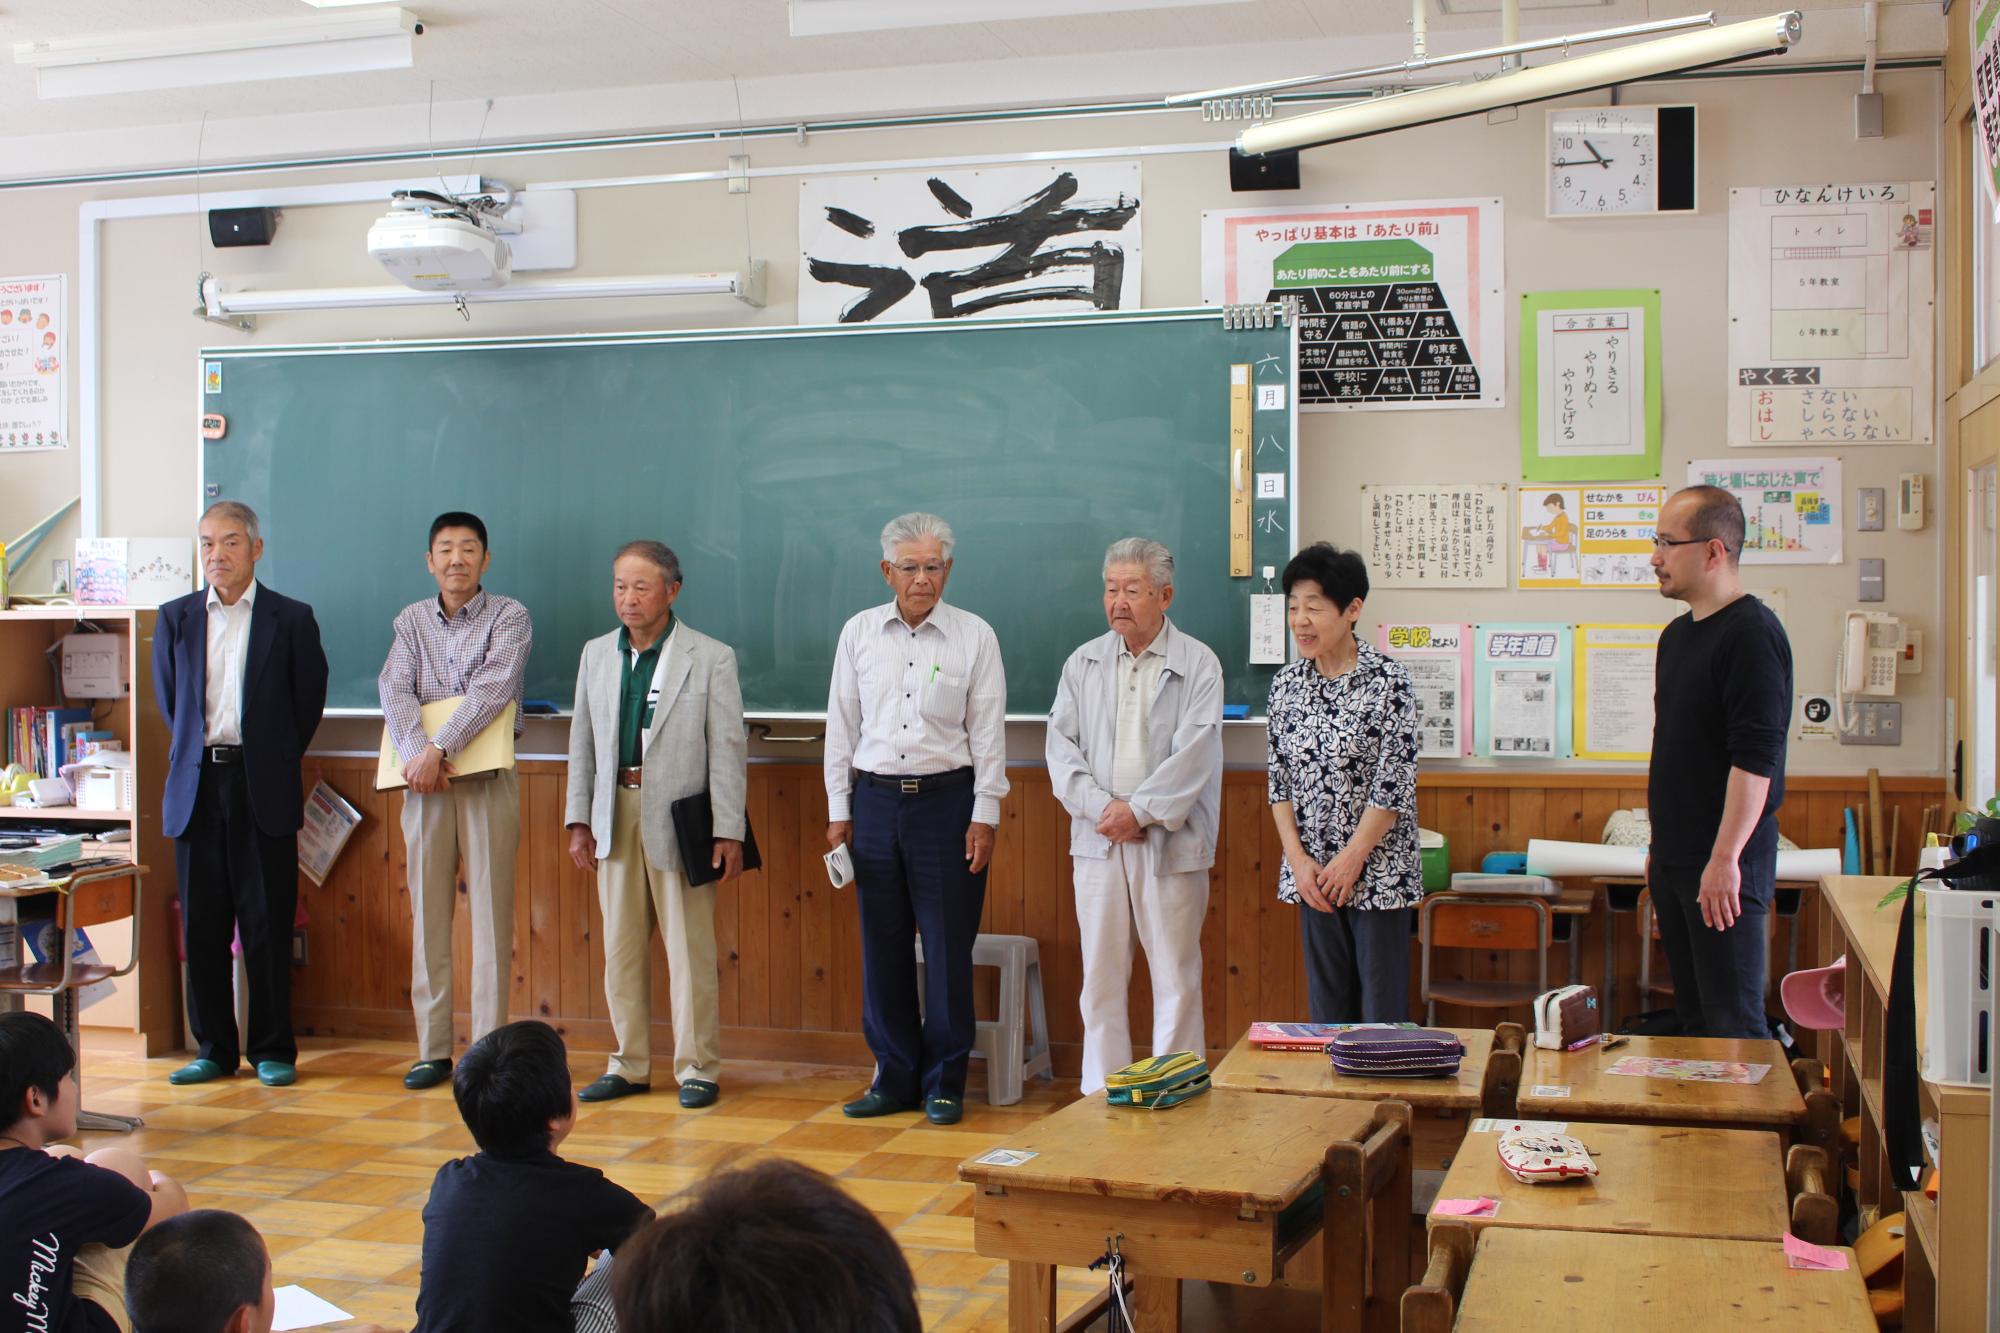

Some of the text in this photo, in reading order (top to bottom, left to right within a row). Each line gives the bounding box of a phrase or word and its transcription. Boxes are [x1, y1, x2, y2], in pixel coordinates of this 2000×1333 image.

[1597, 117, 1607, 128] 12
[1563, 137, 1573, 149] 10
[1633, 136, 1640, 147] 2
[1639, 154, 1647, 166] 3
[1564, 176, 1571, 188] 8
[1633, 174, 1640, 185] 4
[1580, 190, 1587, 202] 7
[1618, 189, 1626, 200] 5
[1775, 185, 1895, 204] ひなんけいろ
[1598, 195, 1606, 206] 6
[1256, 221, 1441, 242] やっぱり基本は「あたり前」
[1793, 226, 1846, 236] トイレ
[1276, 263, 1431, 281] あたり前のことをあたり前にする
[1799, 277, 1840, 287] 5年教室
[1329, 290, 1376, 300] 60分以上の
[1341, 320, 1368, 330] 宿題の
[1424, 316, 1445, 327] 言葉
[1566, 316, 1616, 329] 合言葉
[1304, 330, 1323, 340] 守る
[1386, 327, 1405, 337] 行動
[1420, 328, 1450, 338] づかい
[1799, 327, 1840, 337] 6年教室
[1428, 343, 1458, 354] 約束を
[1433, 356, 1453, 366] 守る
[1605, 336, 1619, 394] やりきる
[1333, 371, 1368, 383] 学校に
[1584, 350, 1598, 409] やりぬく
[1740, 367, 1817, 385] やくそく
[1341, 384, 1362, 396] 来る
[1801, 389, 1858, 405] さない
[1561, 368, 1576, 440] やりとげる
[1802, 408, 1879, 422] しらない
[1586, 492, 1624, 502] せなかを
[1586, 511, 1605, 521] 口を
[1586, 528, 1628, 538] 足のうらを
[1389, 626, 1459, 648] 学校だより
[1490, 634, 1556, 657] 学年通信
[13, 1232, 60, 1310] Mickey
